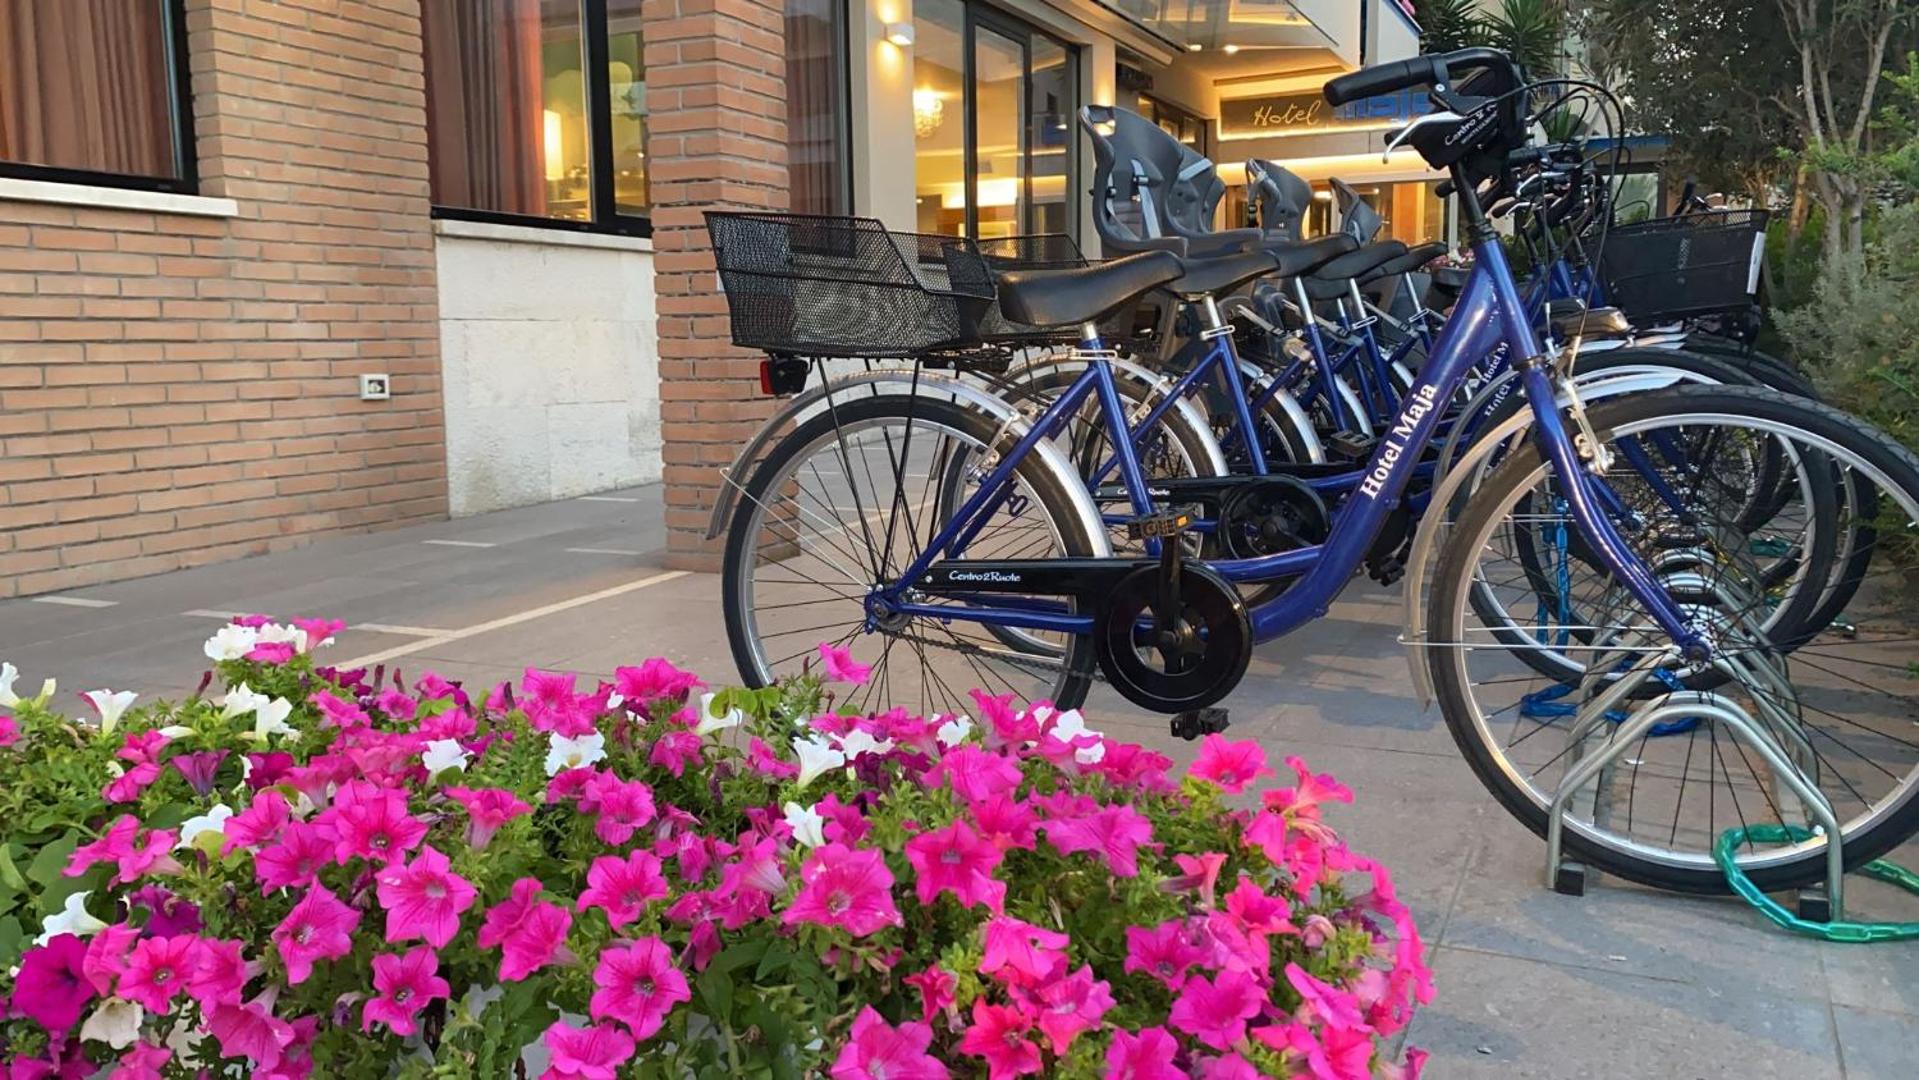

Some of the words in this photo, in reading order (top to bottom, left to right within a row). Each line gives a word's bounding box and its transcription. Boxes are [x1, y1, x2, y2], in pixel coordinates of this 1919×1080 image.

[1253, 100, 1321, 126] Hotel
[1482, 355, 1502, 384] Hotel
[1359, 440, 1404, 500] Hotel
[1392, 384, 1438, 441] Maja
